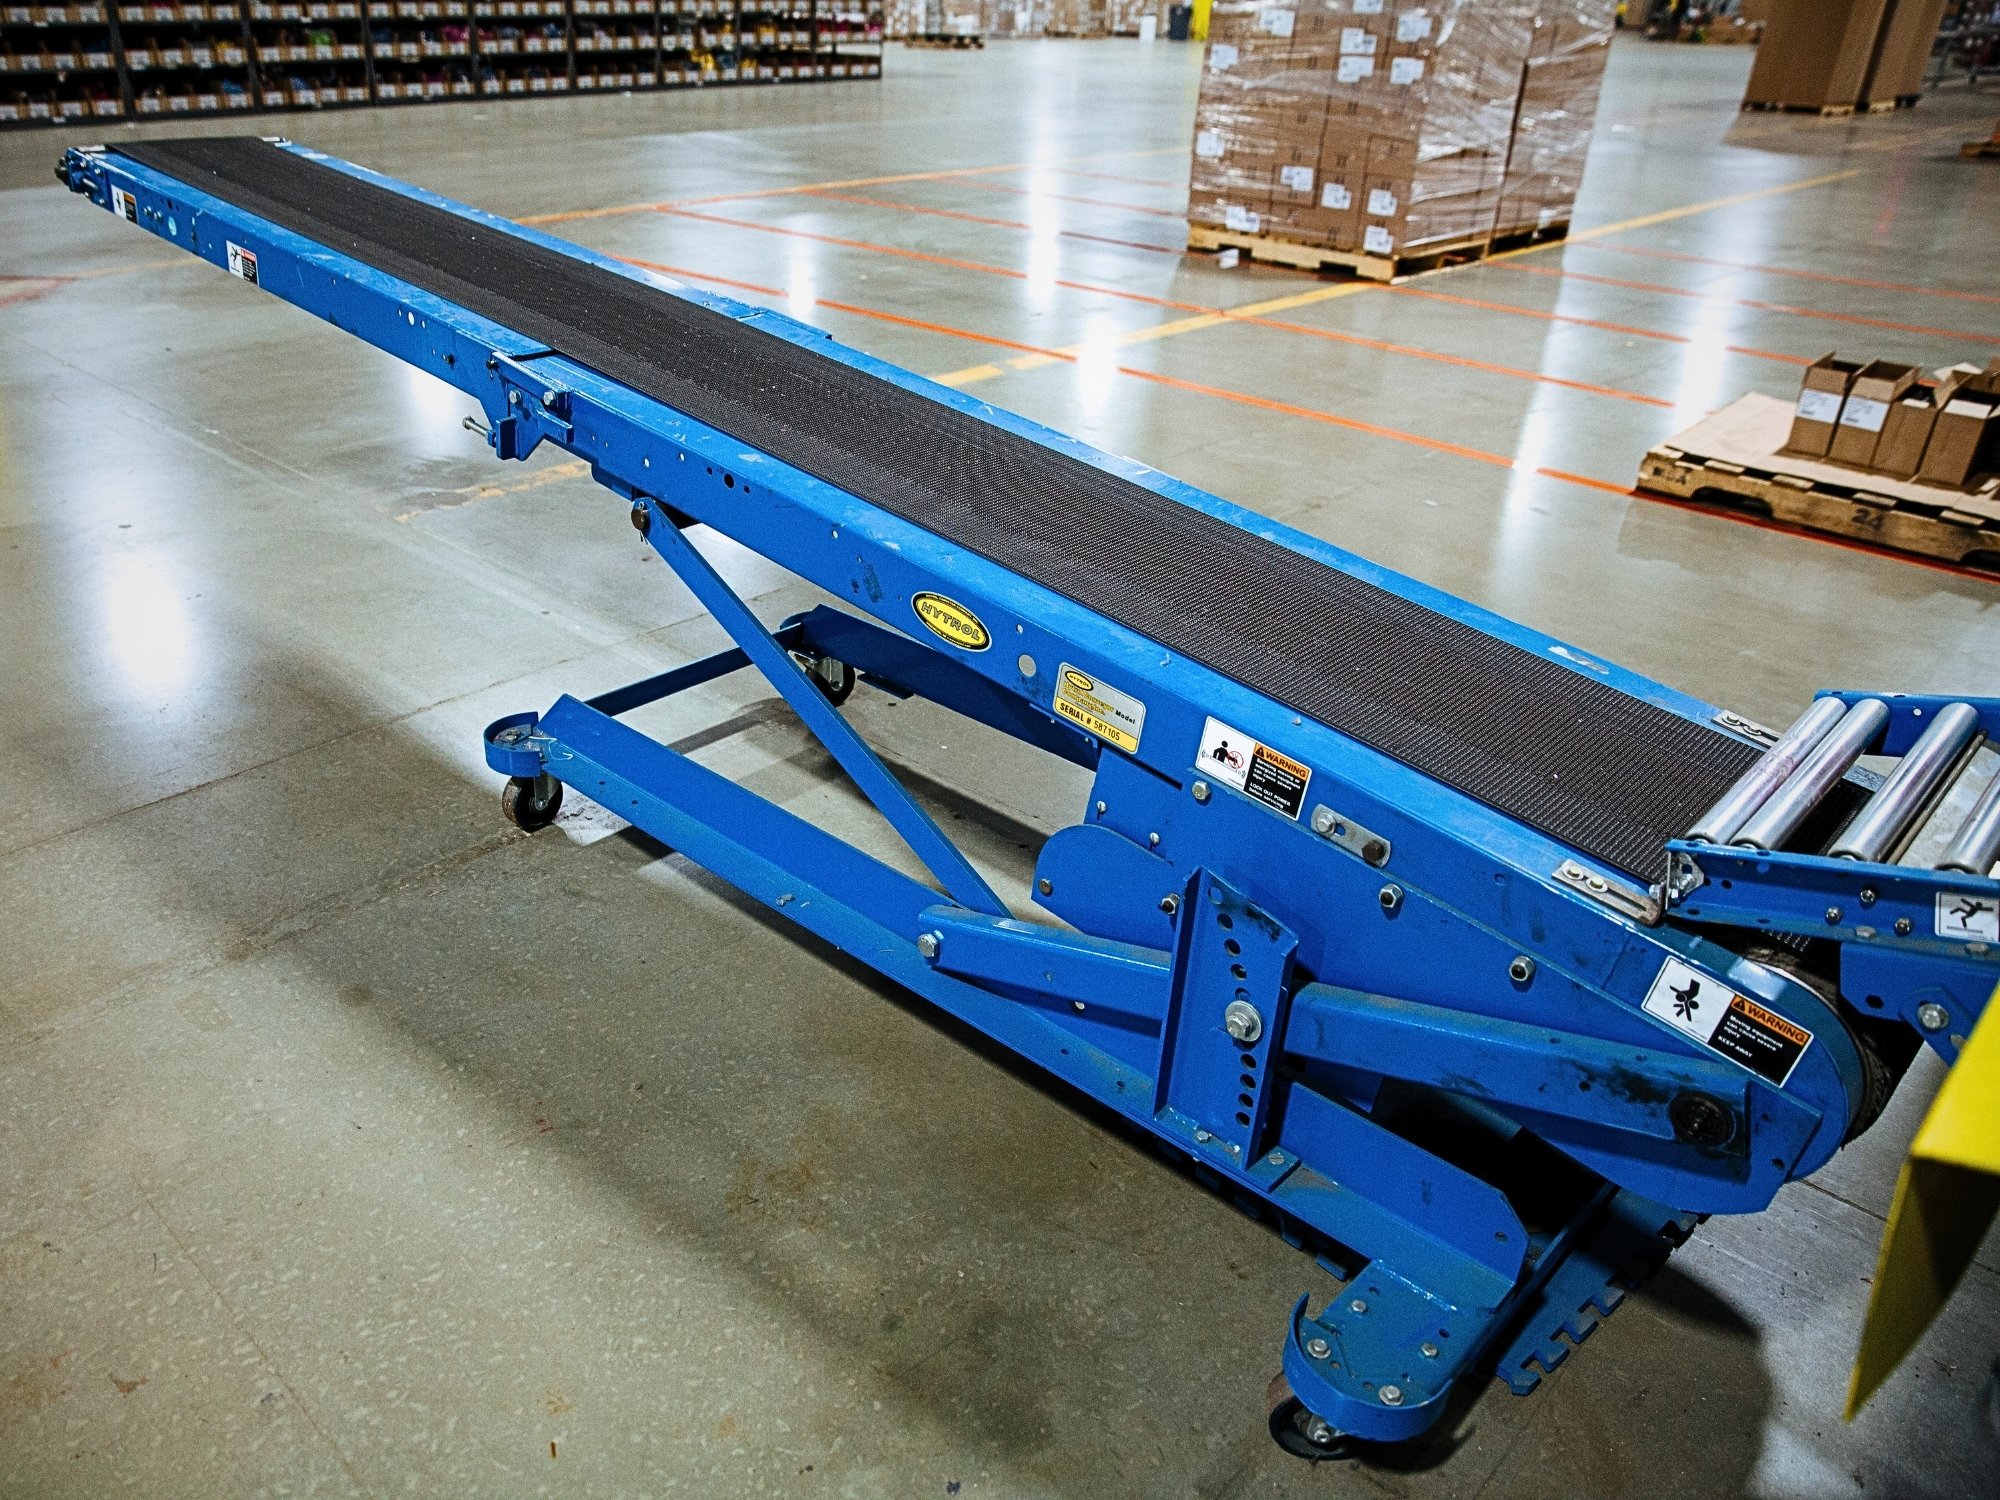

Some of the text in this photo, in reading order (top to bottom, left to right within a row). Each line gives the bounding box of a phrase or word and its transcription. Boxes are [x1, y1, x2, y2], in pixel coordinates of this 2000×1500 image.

[921, 602, 980, 641] HYTROL
[1069, 674, 1090, 688] HYTROL
[1060, 702, 1084, 722] SERIAL
[1094, 720, 1120, 740] 587105
[1116, 710, 1136, 724] Model
[1257, 758, 1276, 772] Servicing
[1266, 752, 1306, 778] WARNING
[1263, 773, 1276, 782] cause
[1277, 780, 1292, 790] severe
[1278, 776, 1300, 790] equipment
[1250, 782, 1262, 792] LOCK
[1263, 788, 1273, 796] OUT
[1274, 794, 1291, 806] POWER
[1730, 1015, 1783, 1049] Moving equipment
[1748, 1006, 1805, 1042] WARNING
[1718, 1035, 1753, 1058] KEEP AWAY
[1739, 1028, 1756, 1040] cause
[1757, 1038, 1776, 1052] severe
